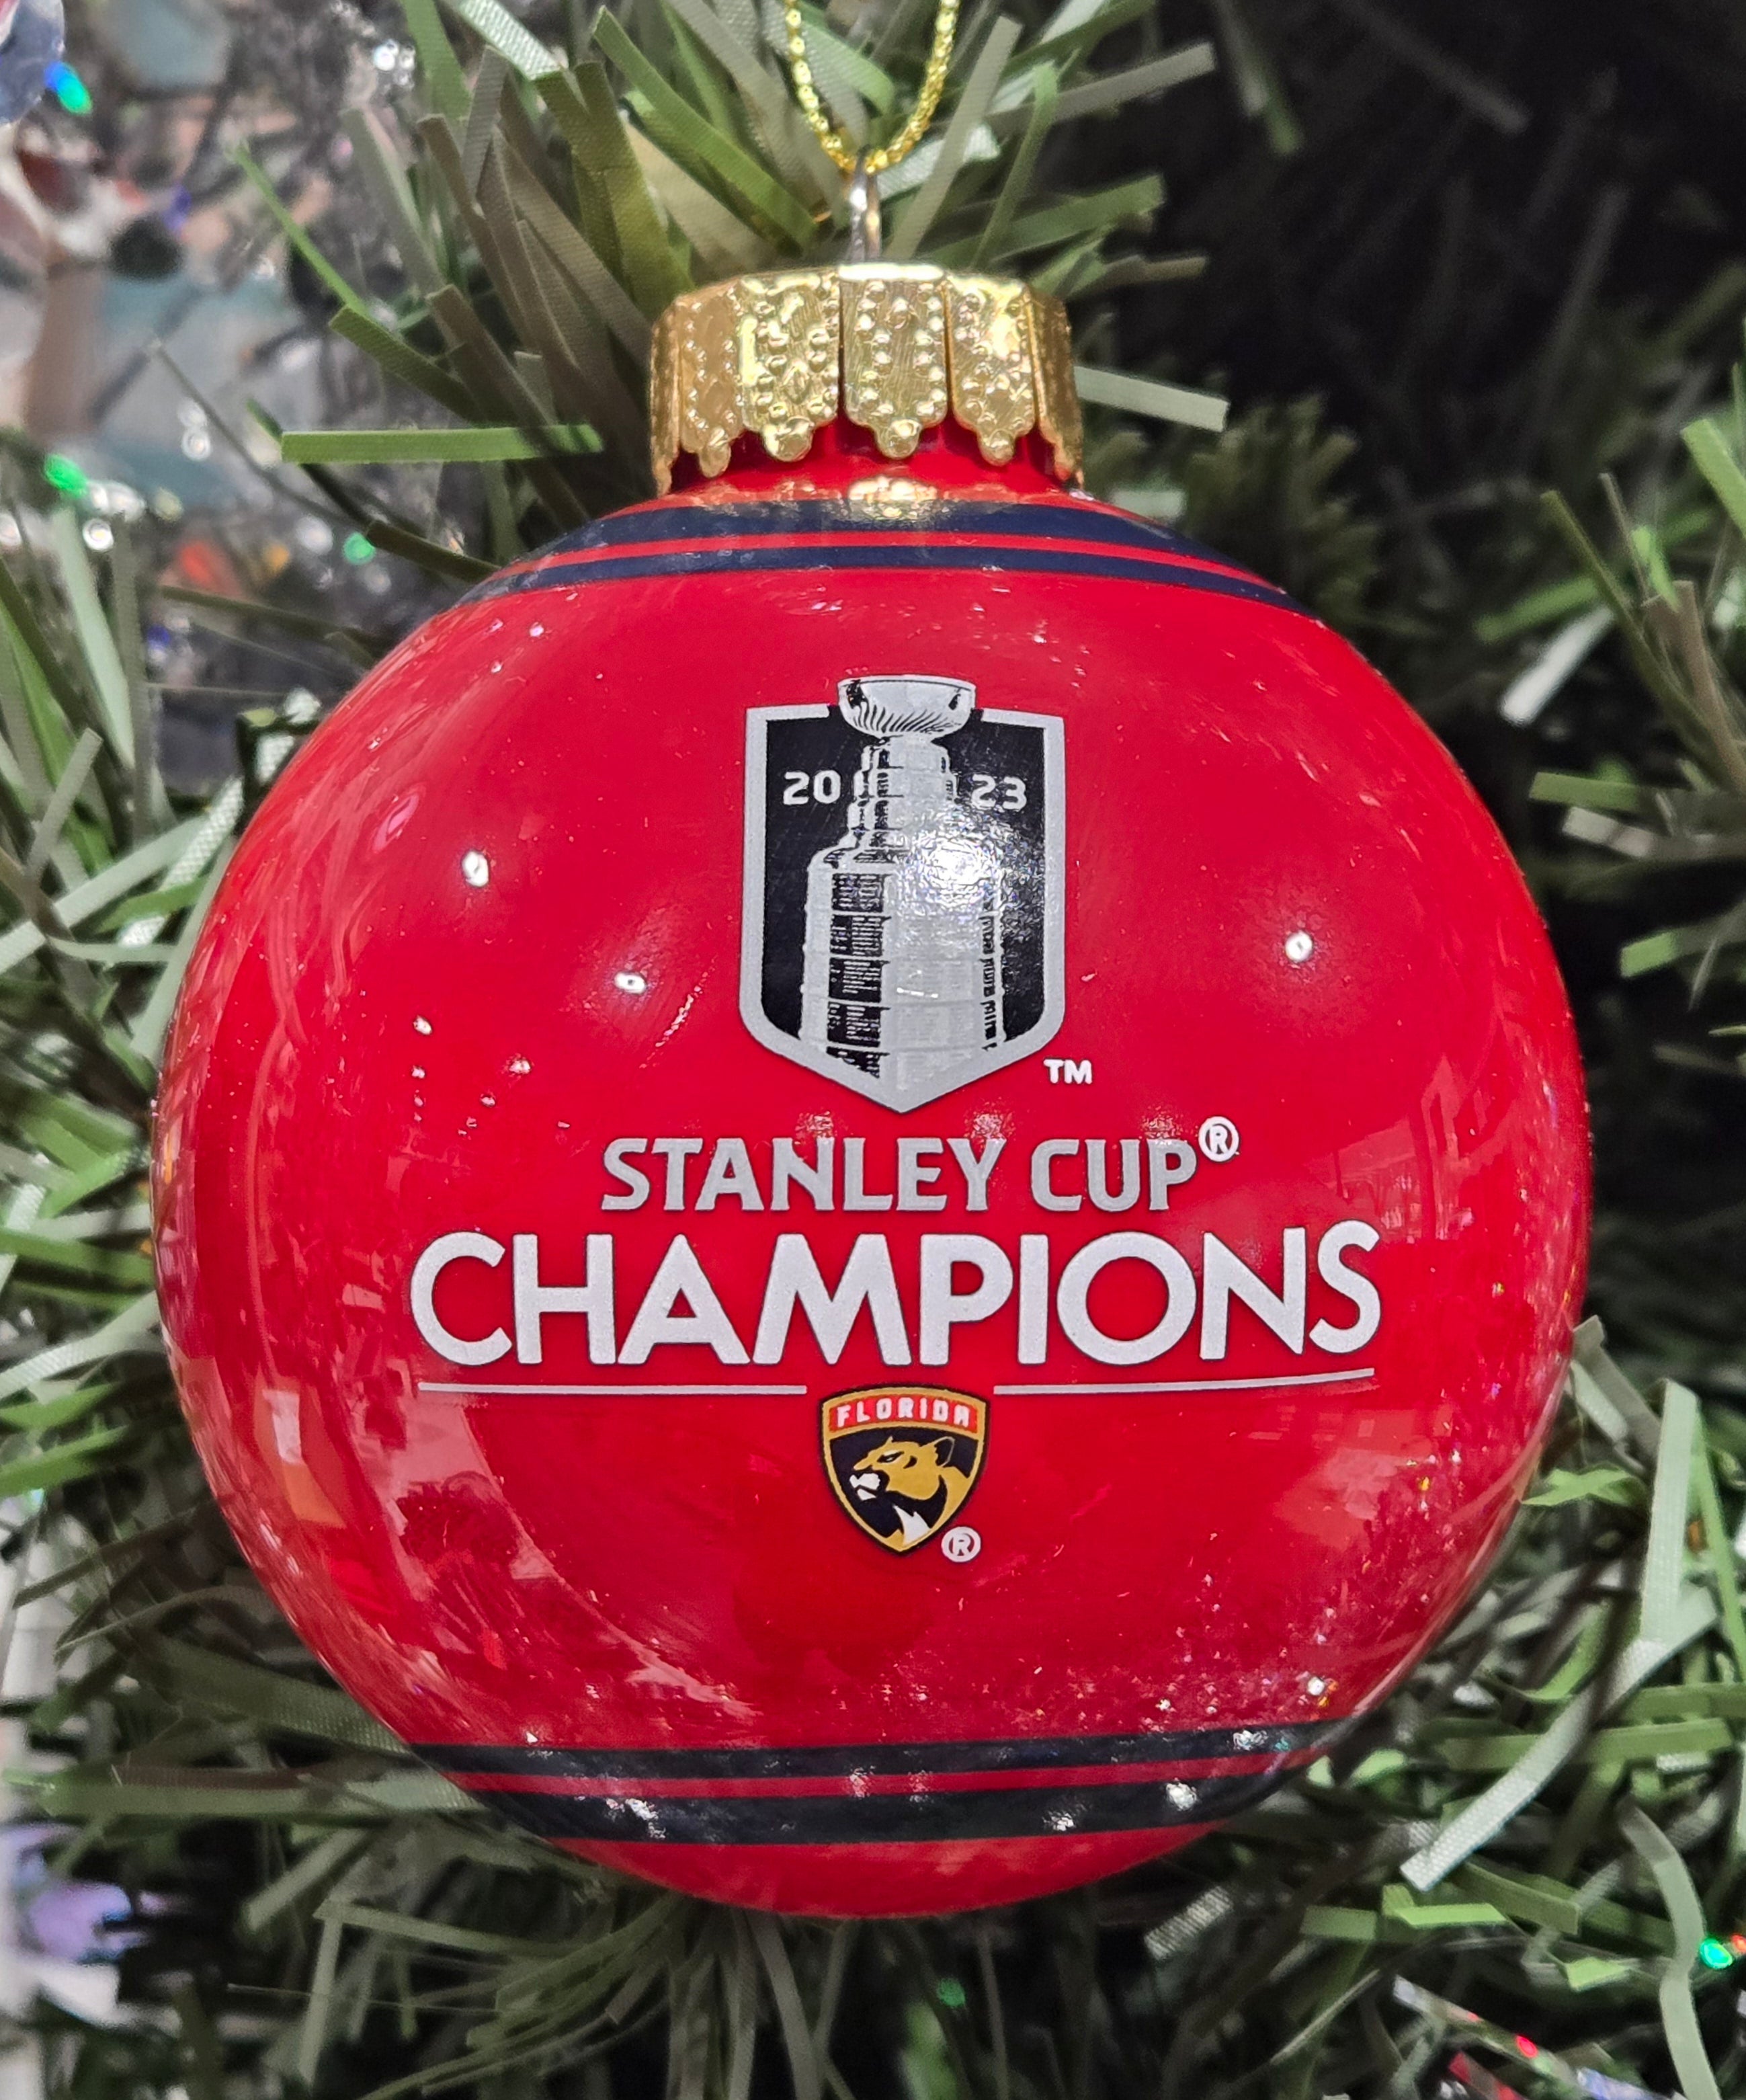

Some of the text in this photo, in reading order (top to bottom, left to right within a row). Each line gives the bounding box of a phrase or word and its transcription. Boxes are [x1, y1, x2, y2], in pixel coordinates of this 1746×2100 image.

[783, 771, 1027, 809] 20 23
[601, 1137, 1007, 1211] STANLEY
[410, 1219, 1381, 1366] CHAMPIONS
[837, 1397, 970, 1428] FLORIDA
